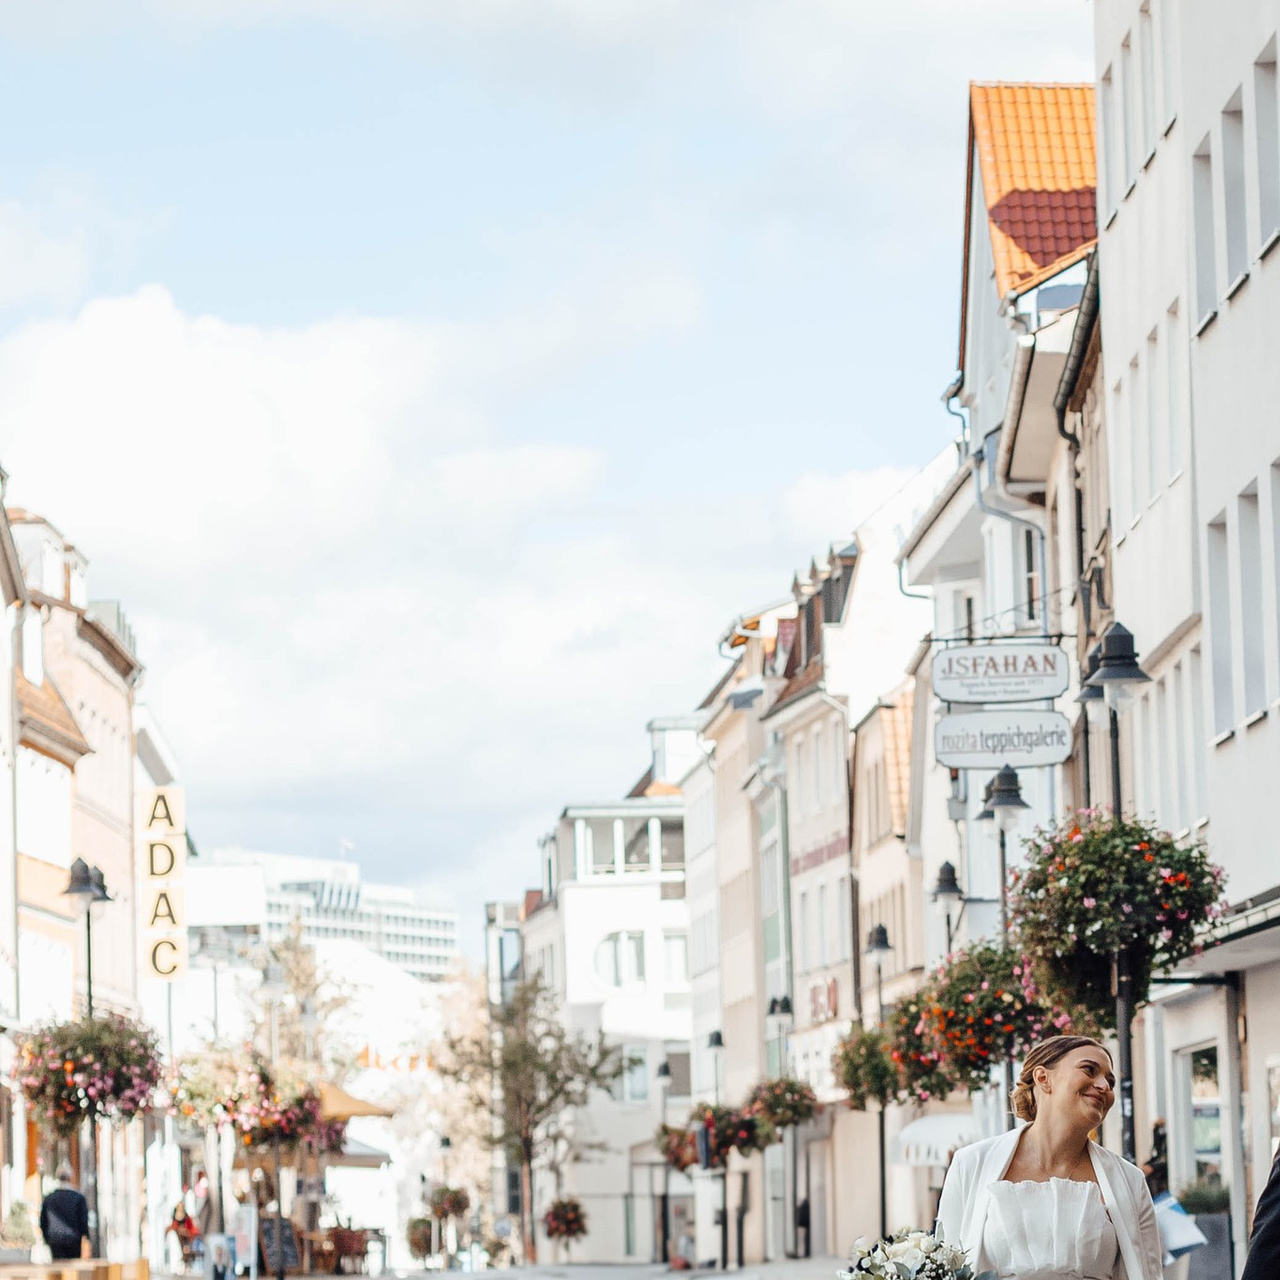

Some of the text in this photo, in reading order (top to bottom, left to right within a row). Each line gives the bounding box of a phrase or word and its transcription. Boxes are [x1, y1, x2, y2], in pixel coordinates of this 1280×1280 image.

[941, 723, 1067, 754] rozita teppichgalerie
[148, 794, 178, 975] ADAC
